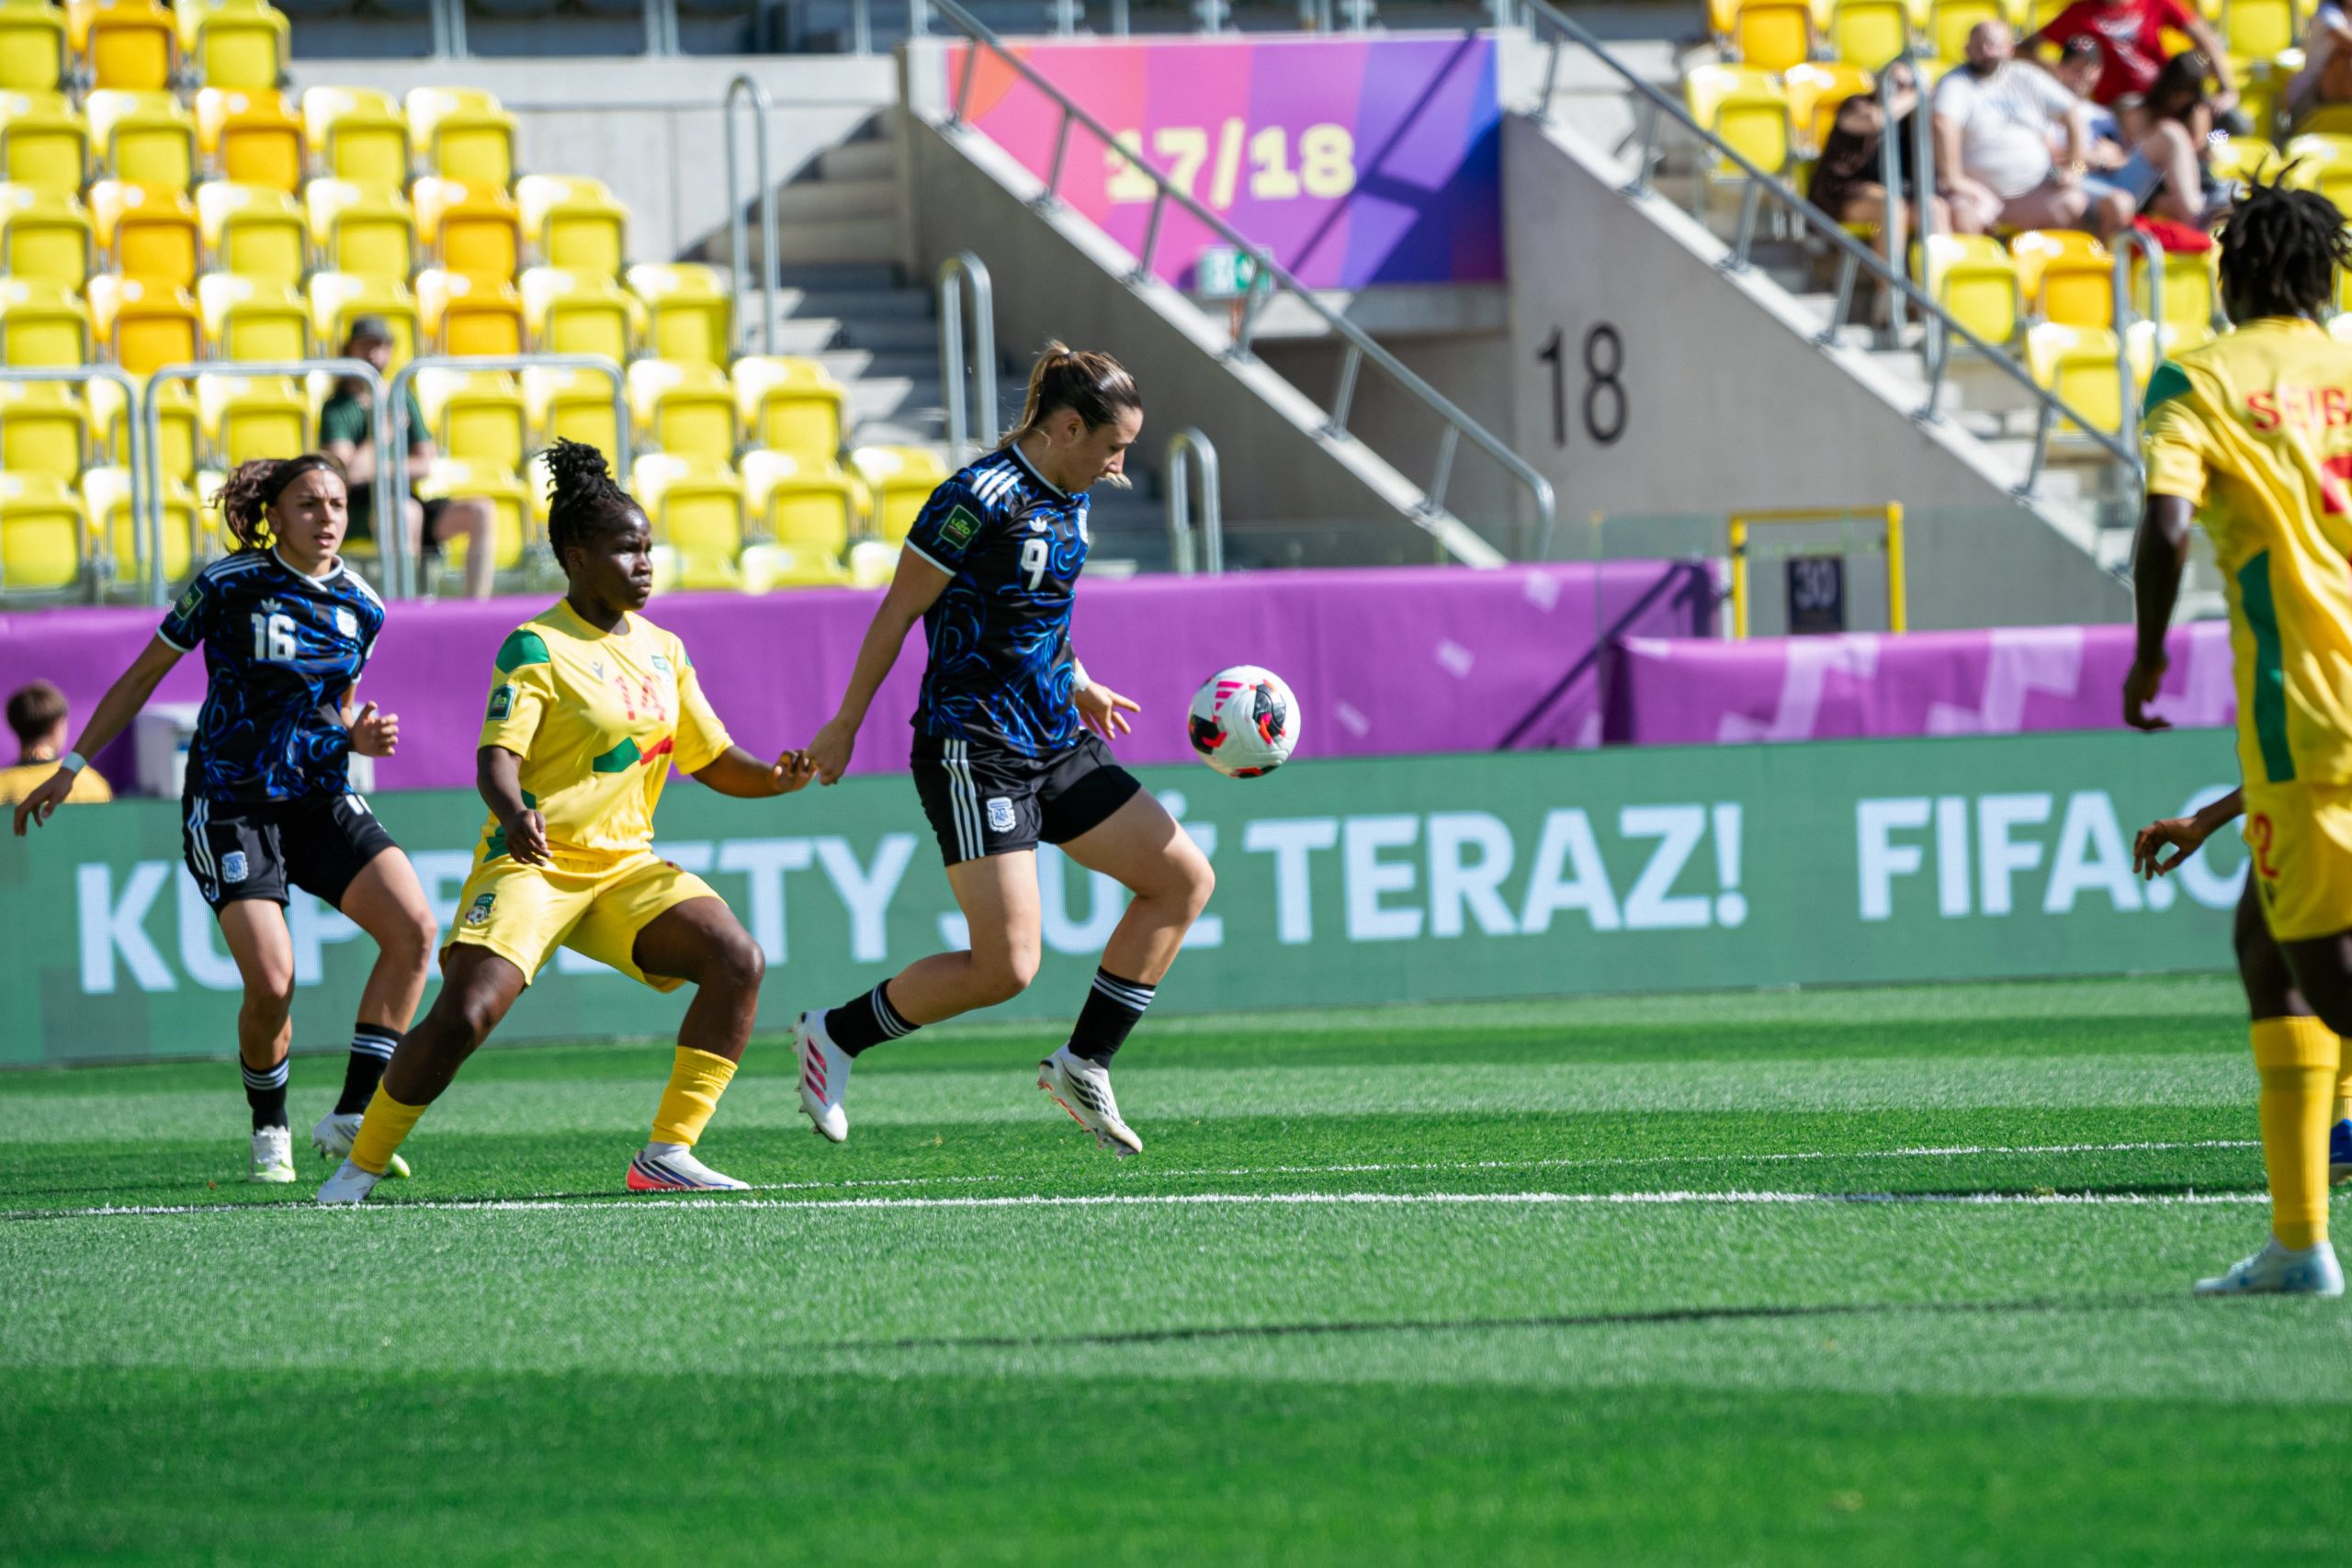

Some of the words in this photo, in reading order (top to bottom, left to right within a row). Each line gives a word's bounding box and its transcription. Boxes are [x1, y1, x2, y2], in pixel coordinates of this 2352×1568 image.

[1105, 118, 1357, 210] 17/18
[1535, 323, 1628, 446] 18
[1021, 538, 1048, 591] 9
[251, 613, 296, 661] 16
[615, 675, 666, 721] 14
[1241, 801, 1748, 944] TERAZ!
